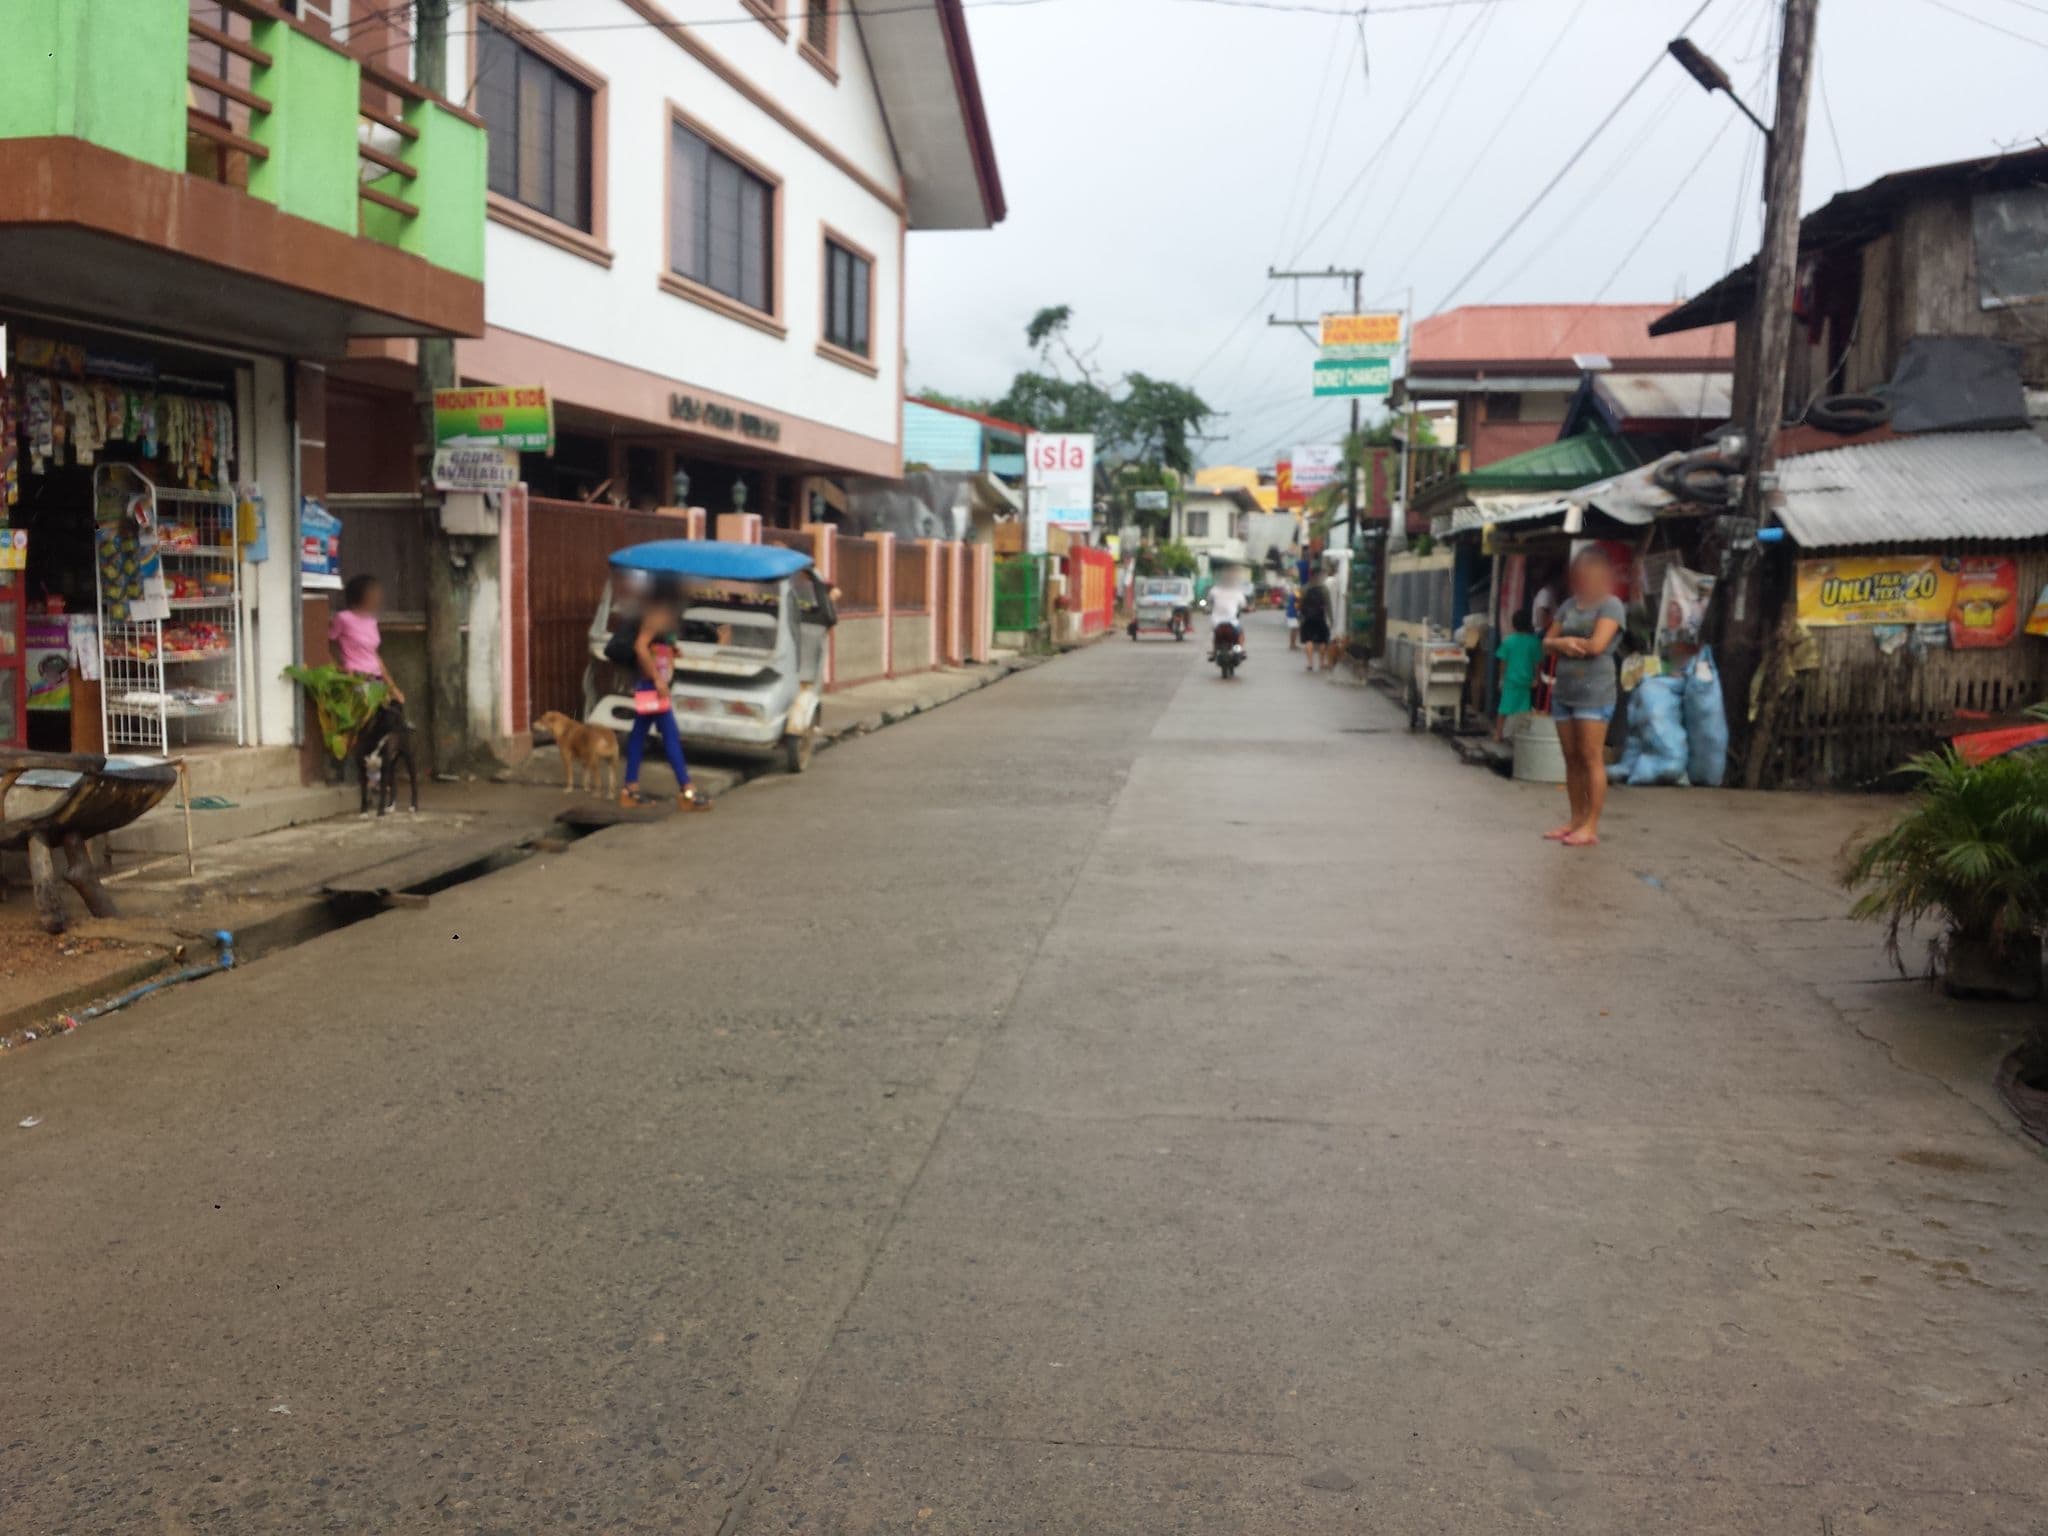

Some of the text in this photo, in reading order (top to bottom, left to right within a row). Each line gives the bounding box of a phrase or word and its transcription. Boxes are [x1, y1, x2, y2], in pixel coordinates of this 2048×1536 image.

[436, 389, 546, 410] MOUNTAIN SIDE
[1033, 437, 1085, 470] isla
[1822, 576, 1873, 606] UNLI
[1904, 570, 1937, 600] 20
